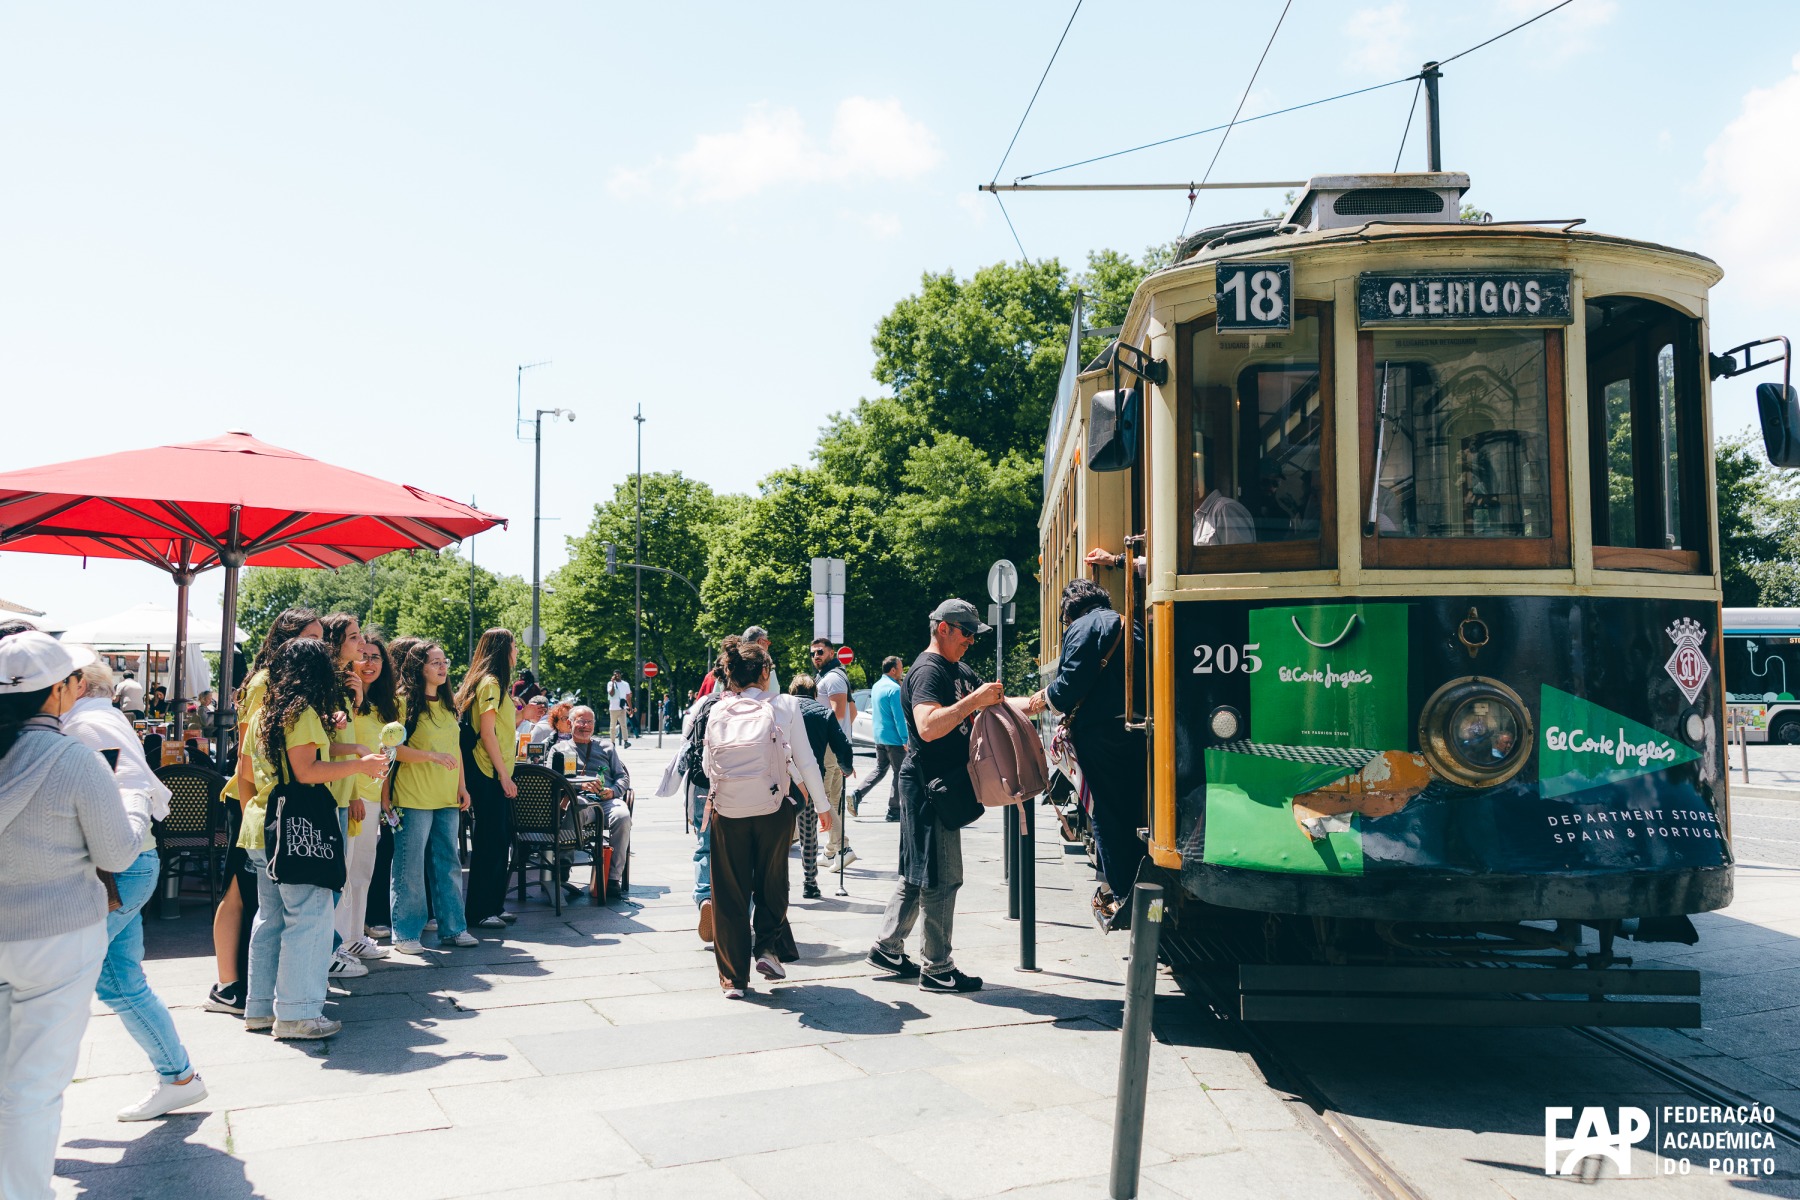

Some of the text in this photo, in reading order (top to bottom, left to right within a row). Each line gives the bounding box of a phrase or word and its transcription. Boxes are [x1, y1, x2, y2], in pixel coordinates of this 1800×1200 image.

[1223, 270, 1283, 321] 18
[1388, 280, 1541, 315] CLERIGOS
[1193, 642, 1263, 674] 205
[1278, 666, 1293, 682] El
[1292, 667, 1323, 682] Corte
[1546, 726, 1568, 750] El
[1568, 729, 1614, 755] Corte
[1548, 810, 1721, 827] DEPARTMENT STORES
[1554, 829, 1615, 844] SPAIN
[1627, 828, 1635, 838] &
[287, 844, 334, 860] PORTO
